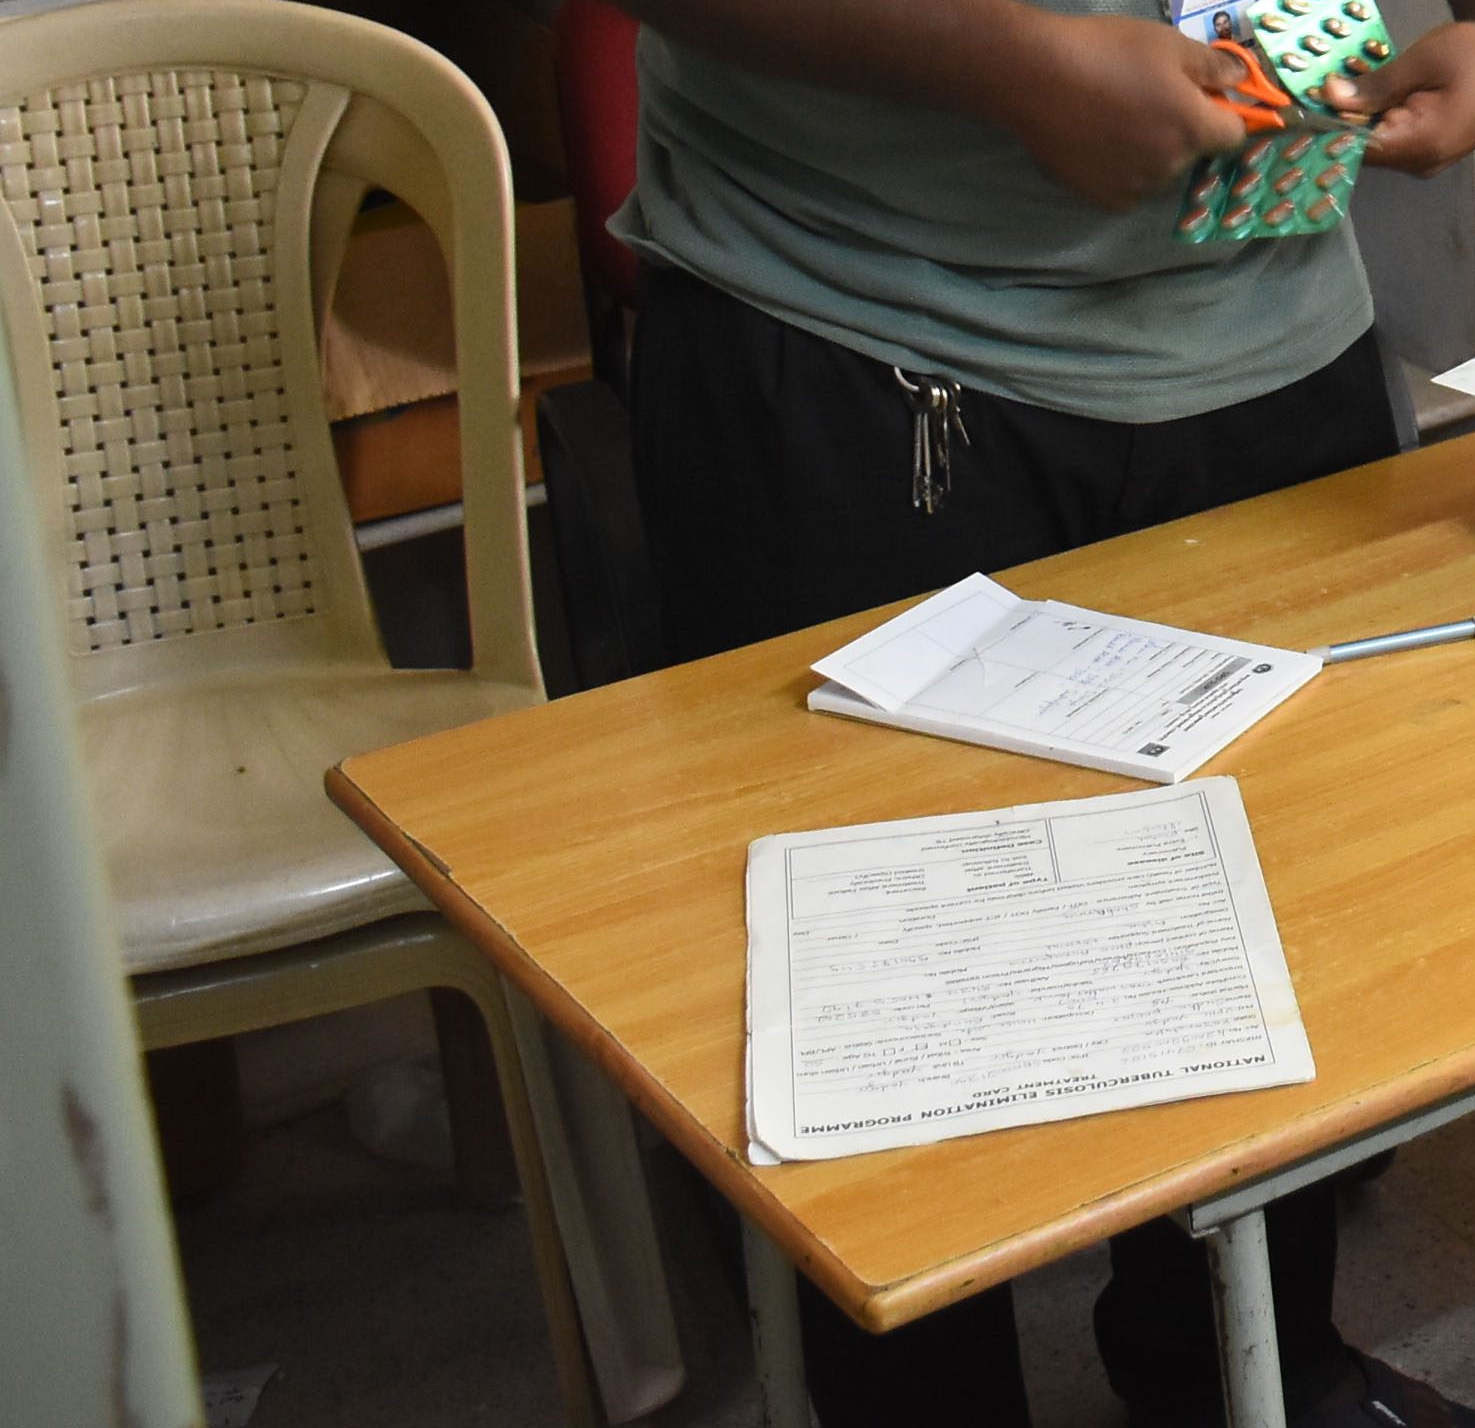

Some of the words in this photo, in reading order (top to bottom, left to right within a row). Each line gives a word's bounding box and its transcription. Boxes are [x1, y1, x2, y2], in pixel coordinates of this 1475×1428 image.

[960, 842, 1014, 854] Definition
[1181, 850, 1204, 858] Site
[1126, 856, 1167, 866] disease
[1021, 876, 1047, 884] Type
[965, 882, 1006, 892] patient
[1179, 1054, 1265, 1074] NATIONAL
[1016, 1073, 1097, 1091] TREATMENT
[1044, 1068, 1173, 1097] TUBERCULOSIS
[971, 1086, 1010, 1098] CARD
[919, 1090, 1038, 1119] ELIMINATION
[799, 1110, 912, 1137] PROGRAMME
